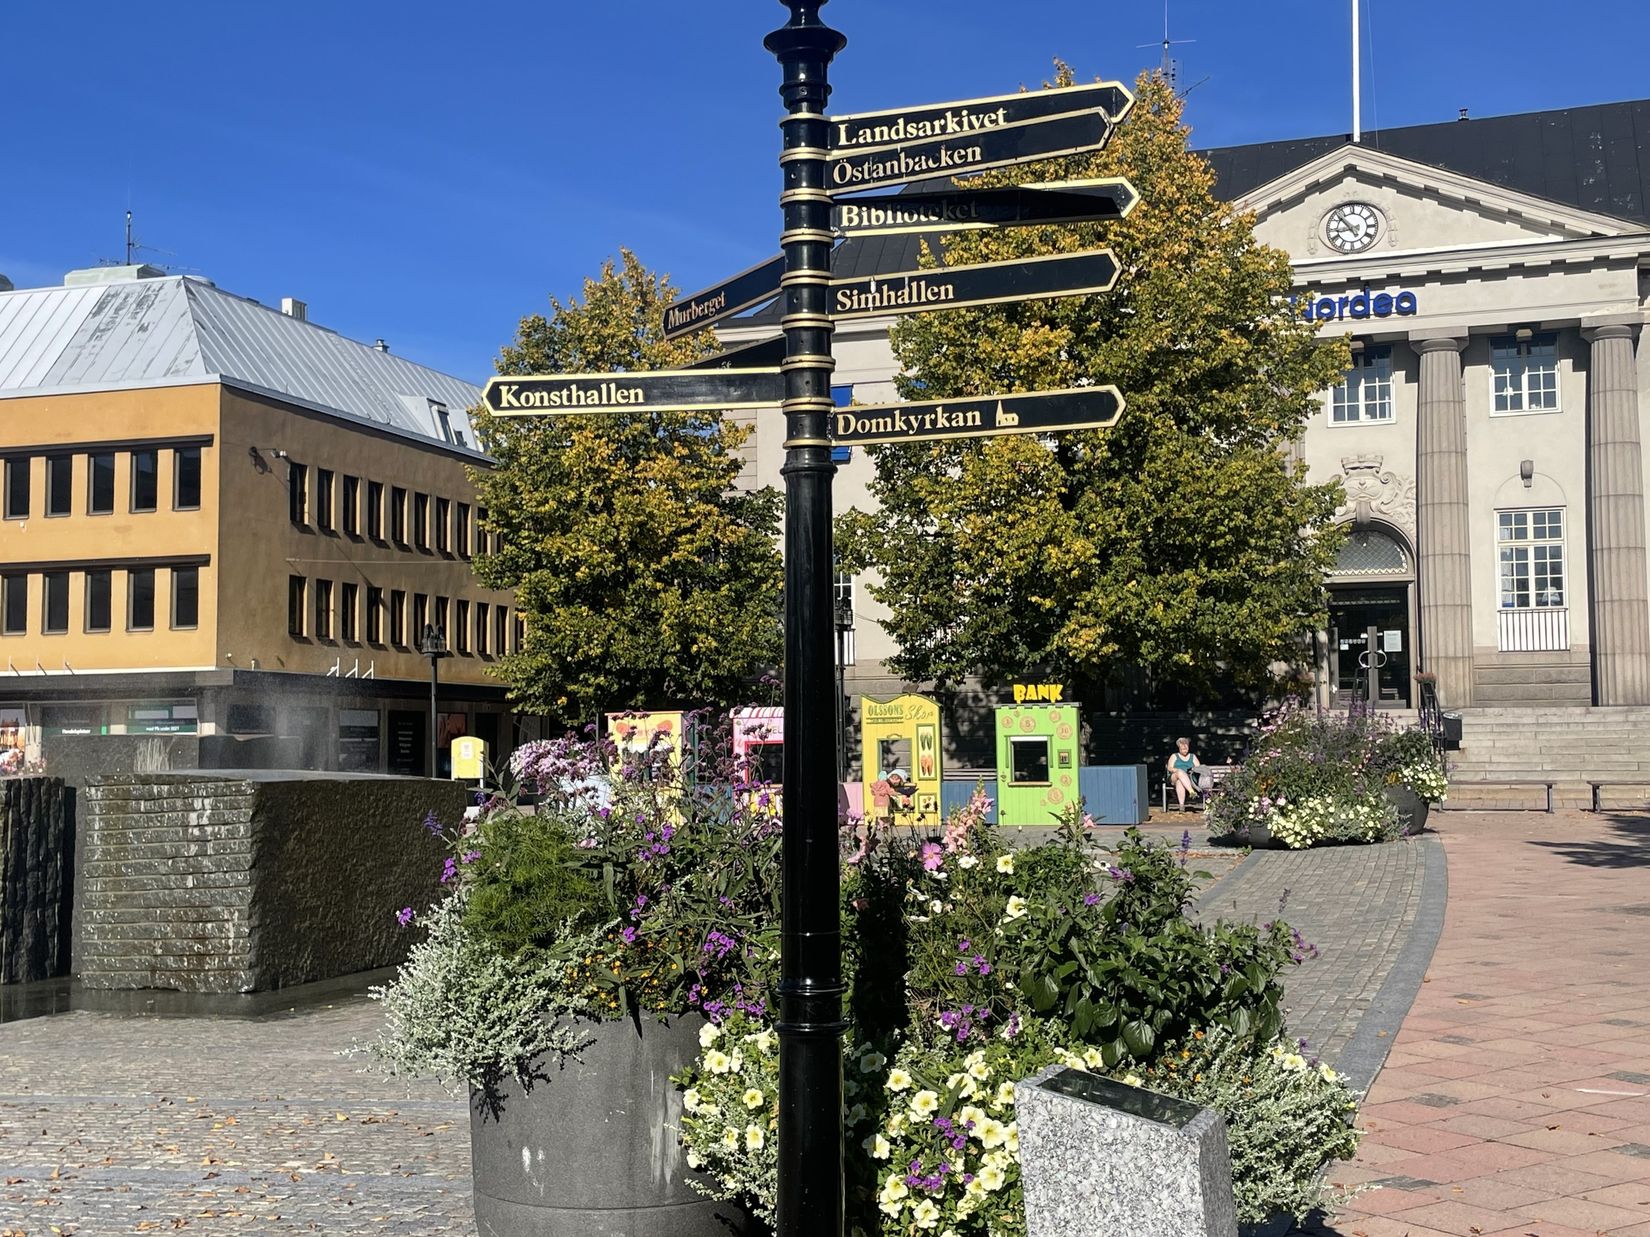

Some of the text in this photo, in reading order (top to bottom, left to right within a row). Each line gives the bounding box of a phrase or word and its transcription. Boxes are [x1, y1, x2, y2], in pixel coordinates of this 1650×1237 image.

[838, 108, 1007, 146] Landsarkivet
[833, 144, 982, 184] Östanbacken
[667, 291, 726, 330] Murberget
[836, 279, 954, 311] Simhallen
[499, 382, 645, 408] Konsthallen
[836, 406, 982, 437] Domkyrkan
[1013, 684, 1063, 702] BANK
[868, 704, 904, 716] OLSSONS
